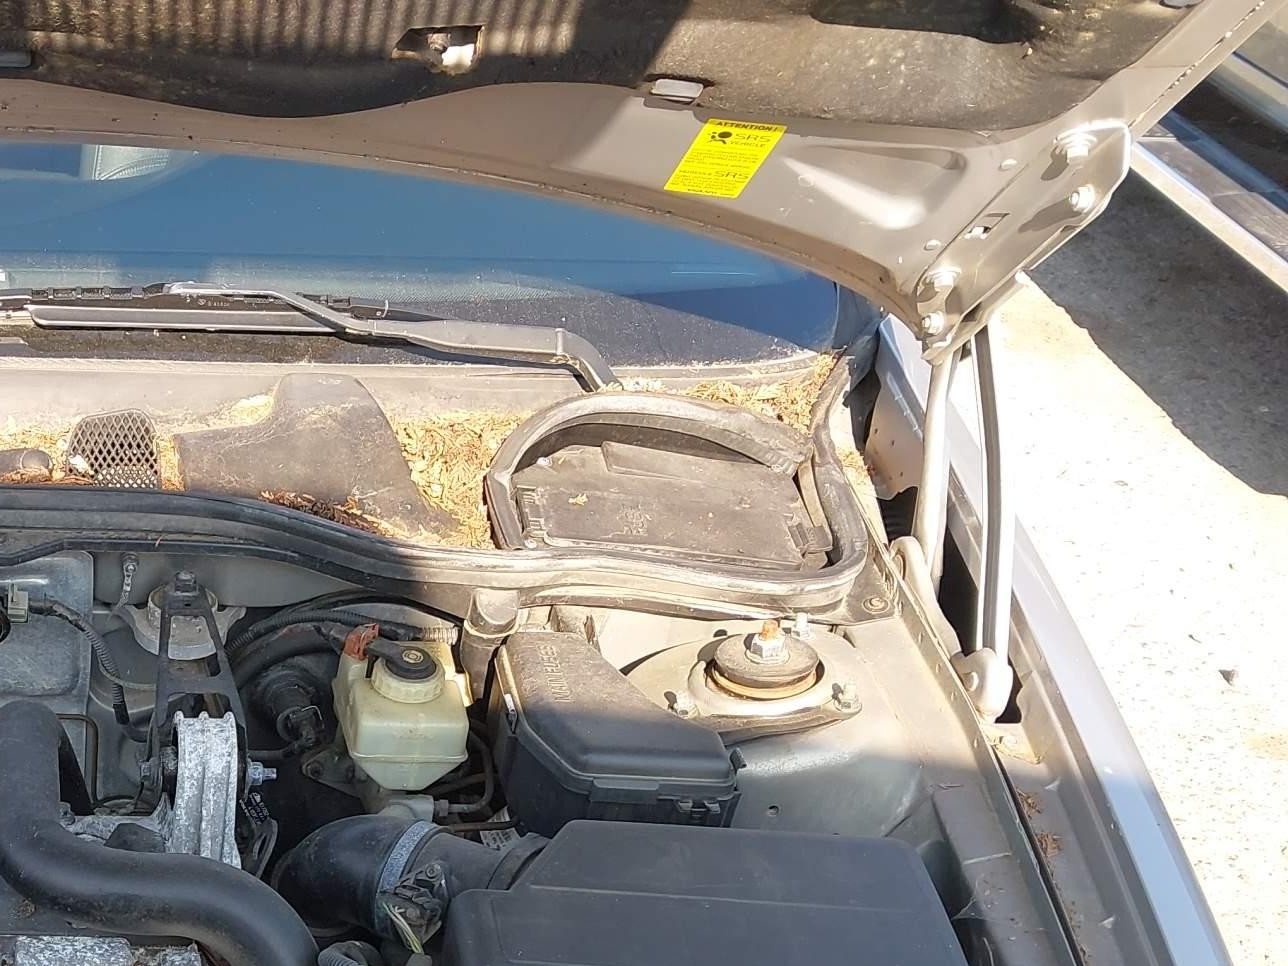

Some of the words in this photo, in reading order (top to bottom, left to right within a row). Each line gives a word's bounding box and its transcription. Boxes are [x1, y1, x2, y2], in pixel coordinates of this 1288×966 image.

[715, 121, 778, 132] ATTENTION!
[735, 133, 771, 143] SRS
[714, 170, 749, 179] SRS
